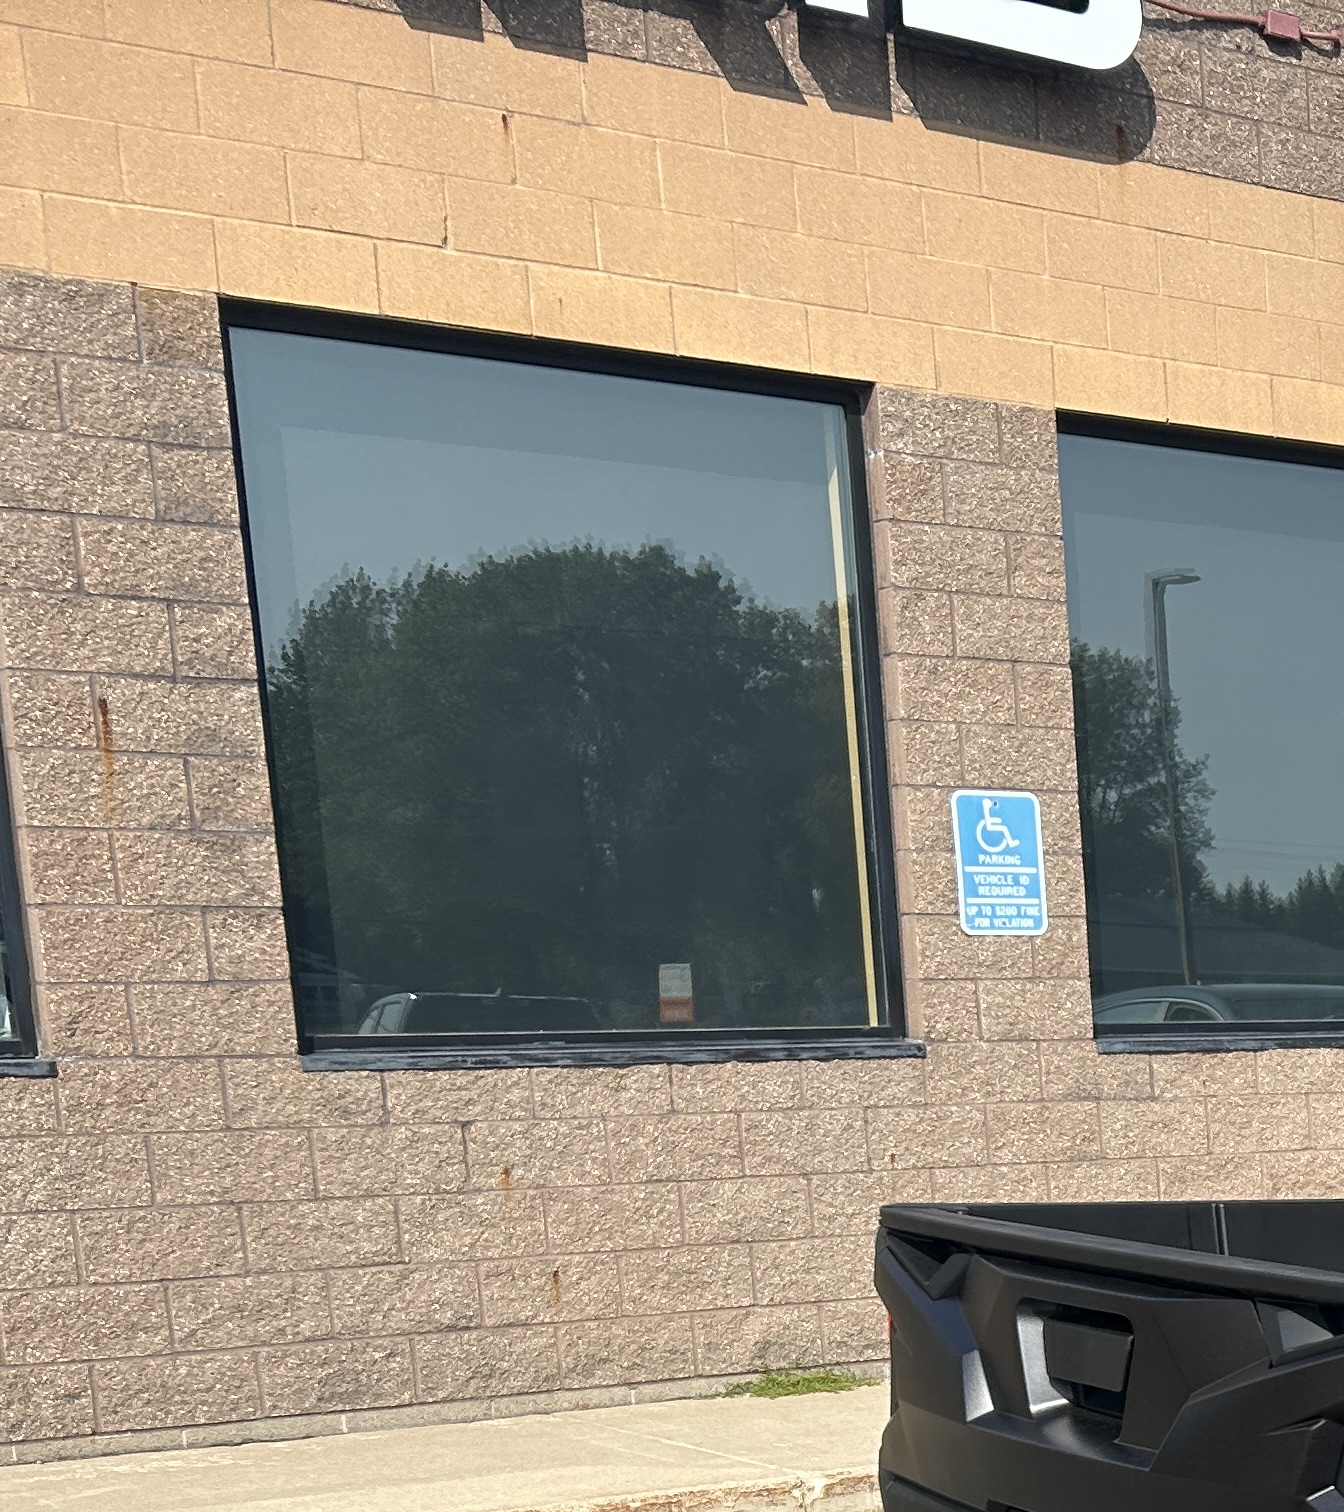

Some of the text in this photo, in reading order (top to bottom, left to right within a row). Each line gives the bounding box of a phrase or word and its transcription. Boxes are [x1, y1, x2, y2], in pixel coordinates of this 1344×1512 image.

[978, 854, 1021, 865] PARKING
[973, 874, 1030, 885] VEHICLE ID
[978, 886, 1027, 896] REQUIRED
[966, 906, 979, 916] UP
[981, 906, 992, 916] TO
[995, 906, 1018, 917] $200
